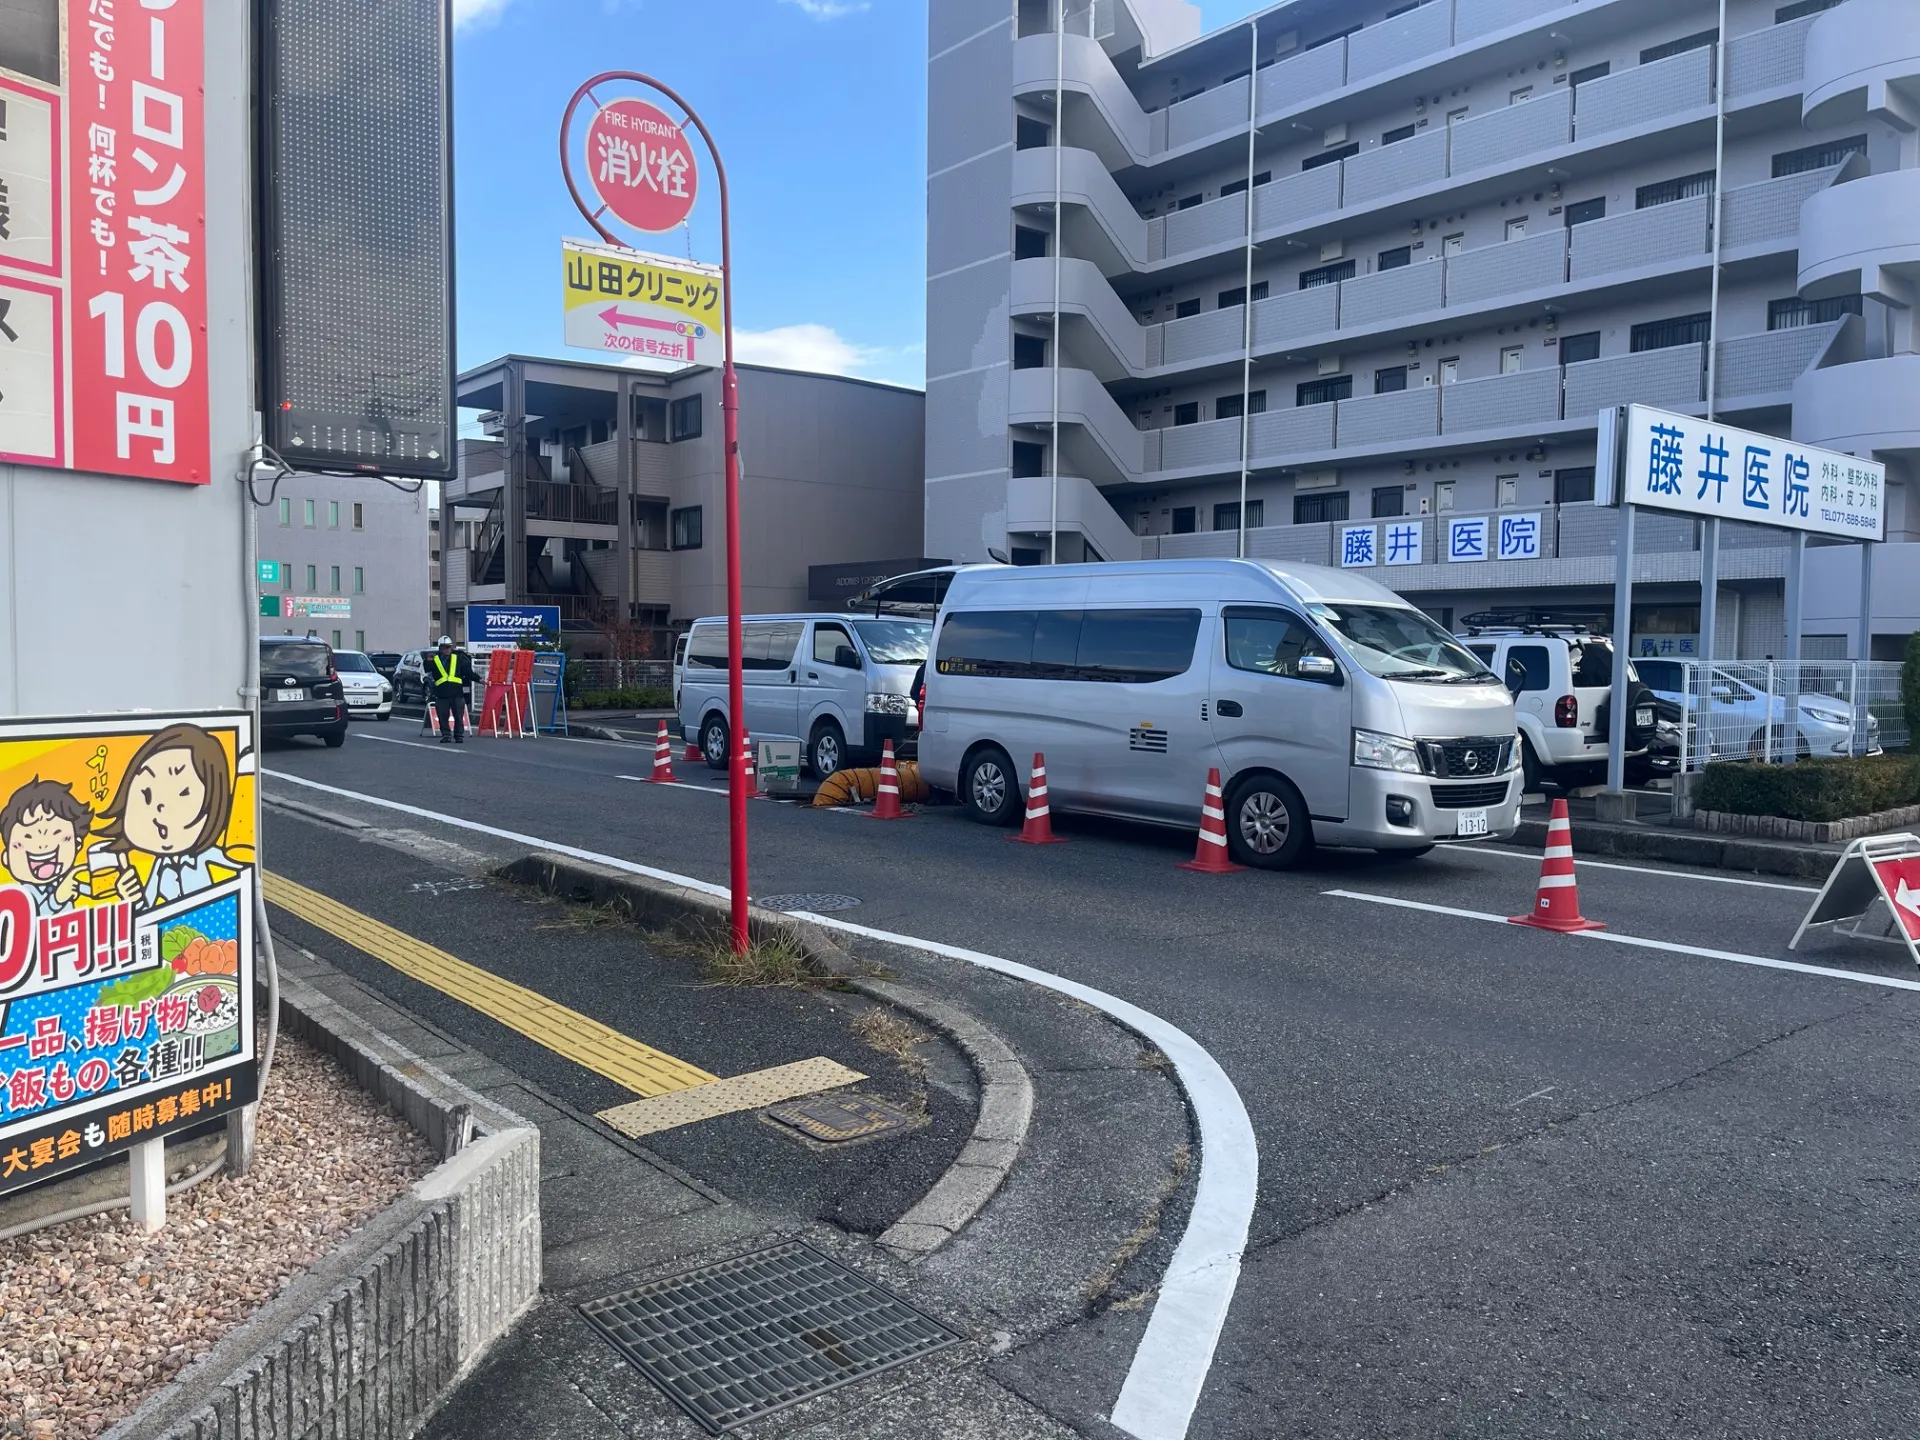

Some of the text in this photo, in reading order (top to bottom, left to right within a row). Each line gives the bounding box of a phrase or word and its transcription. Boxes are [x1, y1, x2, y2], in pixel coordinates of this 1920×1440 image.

[127, 0, 191, 293] ーロン茶
[604, 110, 678, 140] FIRE HYDRANT
[597, 132, 690, 198] 消火栓
[567, 256, 719, 311] 山田クリニック
[604, 333, 684, 359] 次の信号左折
[1647, 423, 1810, 518] 藤井医院
[1344, 517, 1536, 564] 藤井医院
[485, 614, 543, 626] アパマンショップ
[140, 933, 152, 960] 税別
